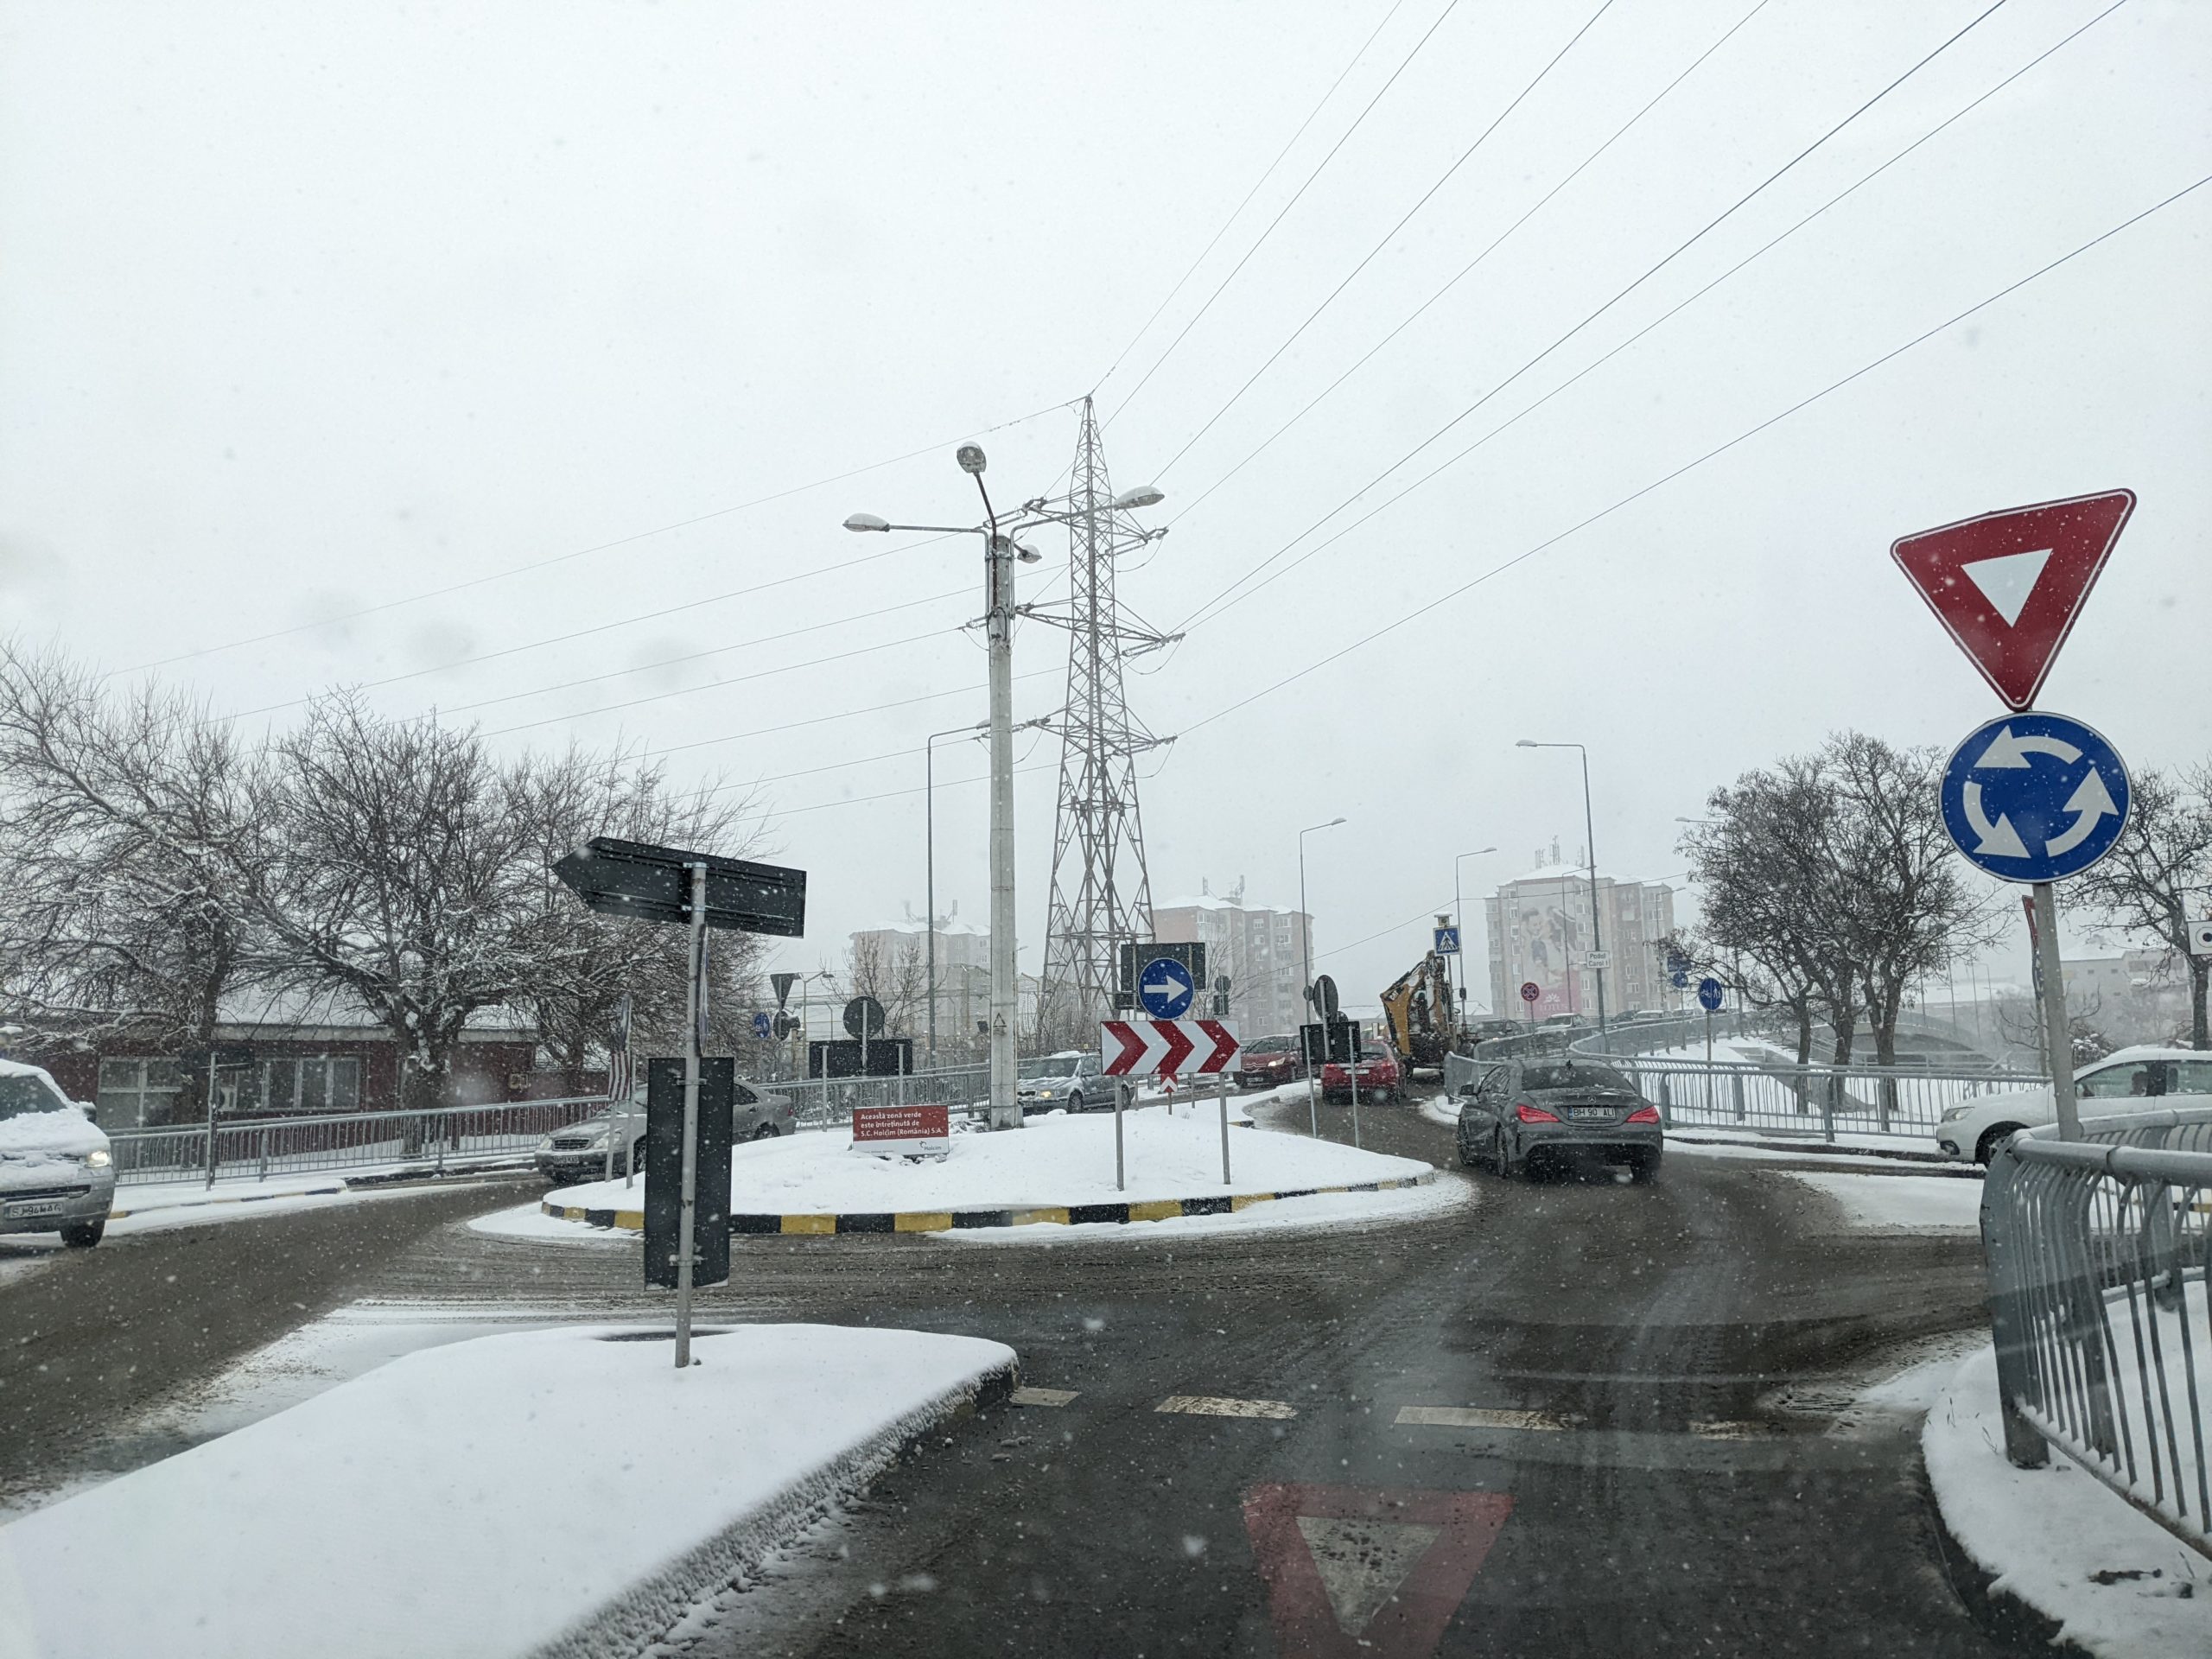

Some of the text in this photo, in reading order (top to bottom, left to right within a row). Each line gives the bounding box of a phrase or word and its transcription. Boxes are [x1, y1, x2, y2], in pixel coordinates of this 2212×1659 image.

[1573, 1108, 1614, 1116] BH 90 ALI
[897, 1128, 931, 1136] (România)
